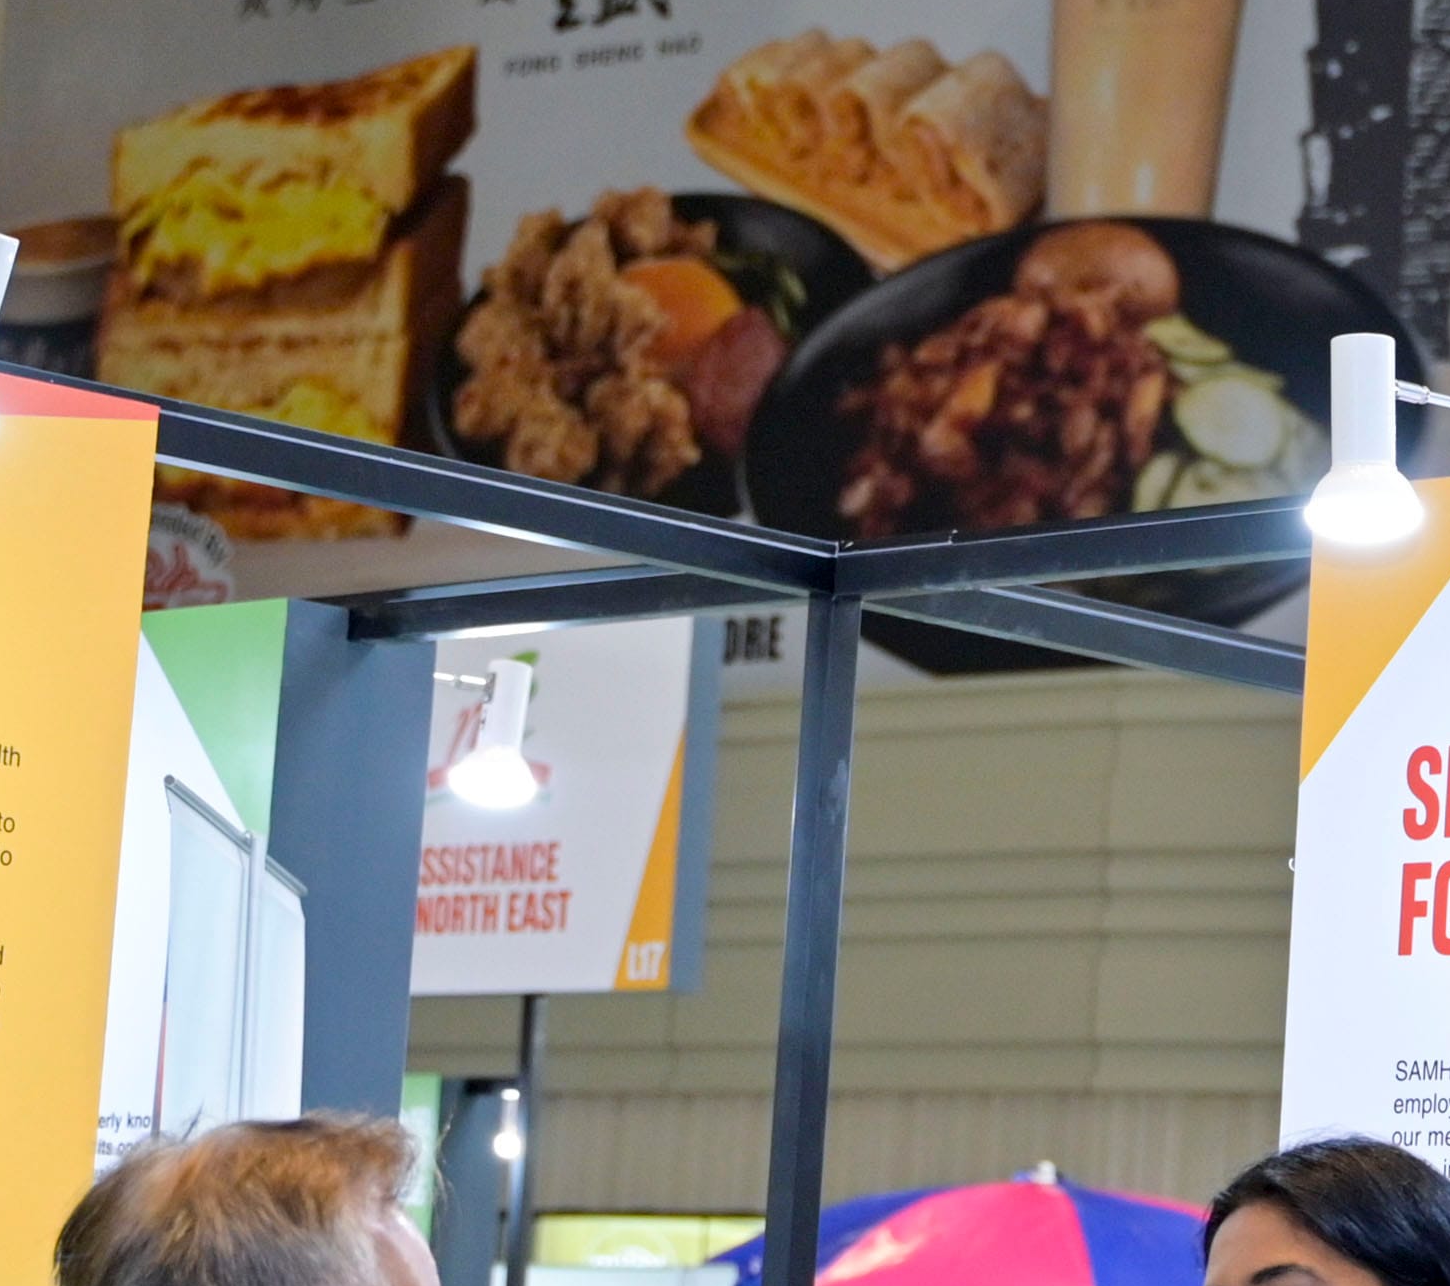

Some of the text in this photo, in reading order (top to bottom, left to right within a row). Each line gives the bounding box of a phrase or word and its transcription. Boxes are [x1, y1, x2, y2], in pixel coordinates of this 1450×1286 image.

[415, 891, 572, 934] NORTH EAST
[627, 941, 666, 981] L17
